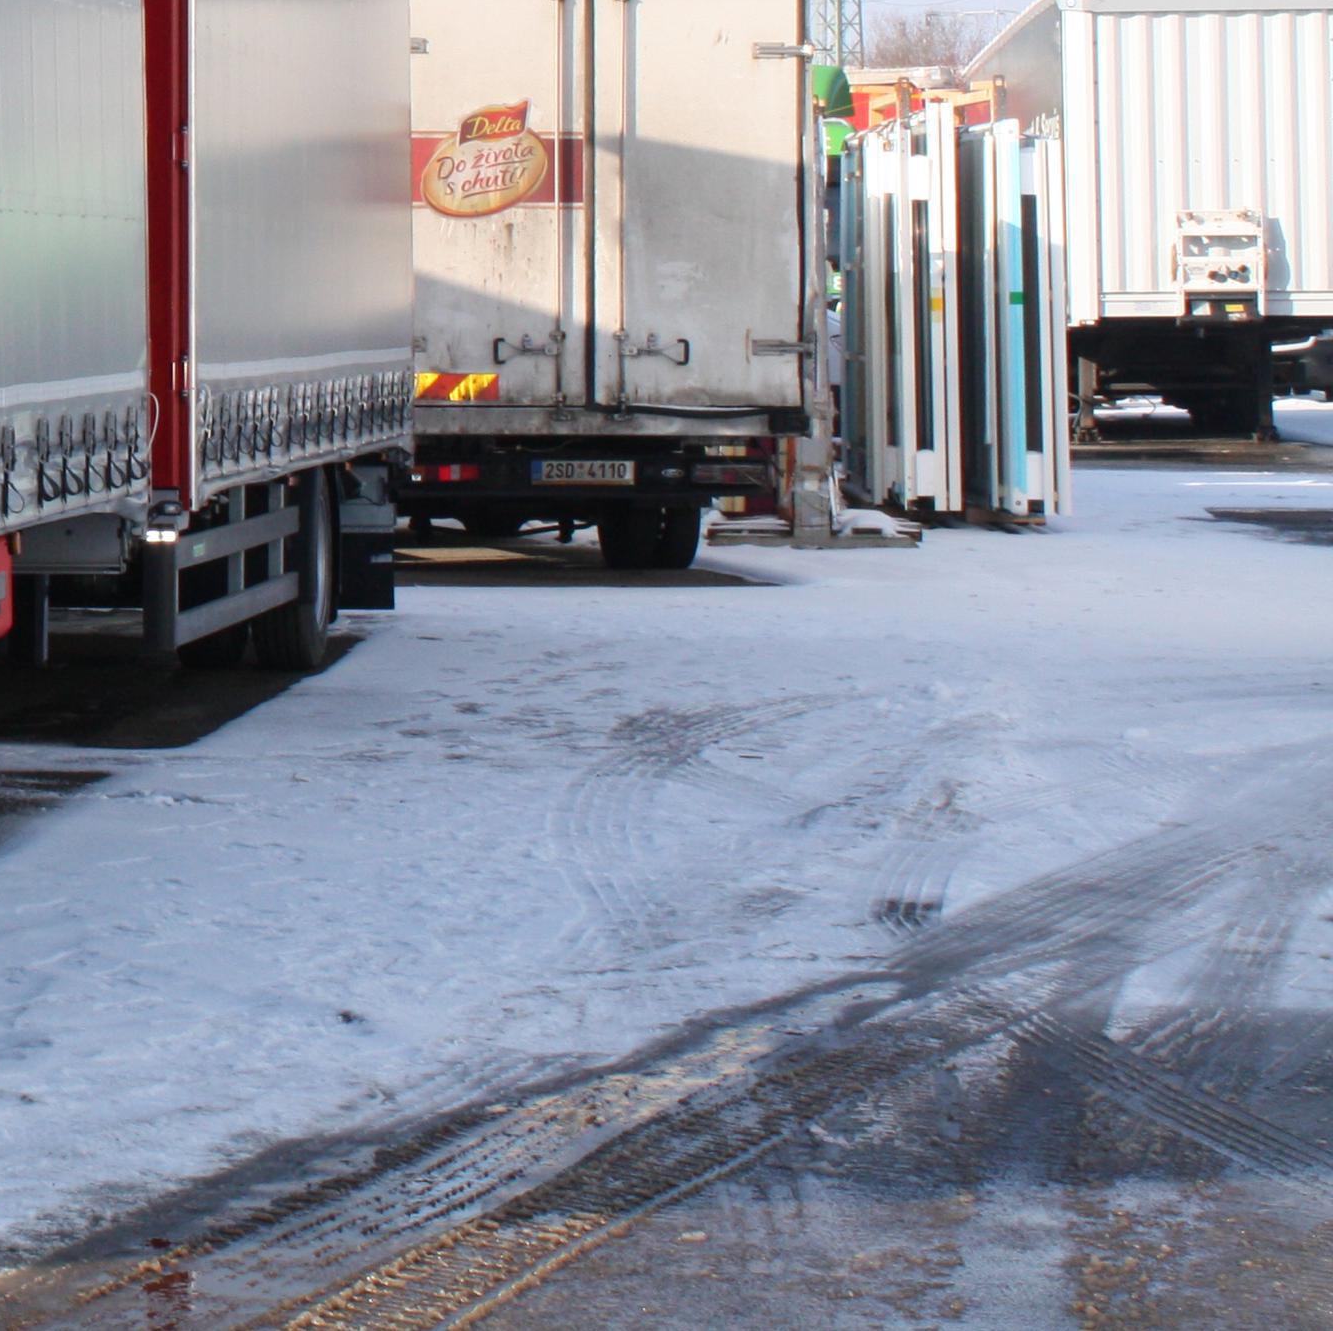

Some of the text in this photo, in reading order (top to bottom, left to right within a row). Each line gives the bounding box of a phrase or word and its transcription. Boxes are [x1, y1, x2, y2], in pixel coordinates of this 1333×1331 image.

[465, 116, 523, 138] Delta
[436, 141, 534, 180] Do života
[445, 181, 455, 195] s
[545, 462, 627, 479] 2SD 4110
